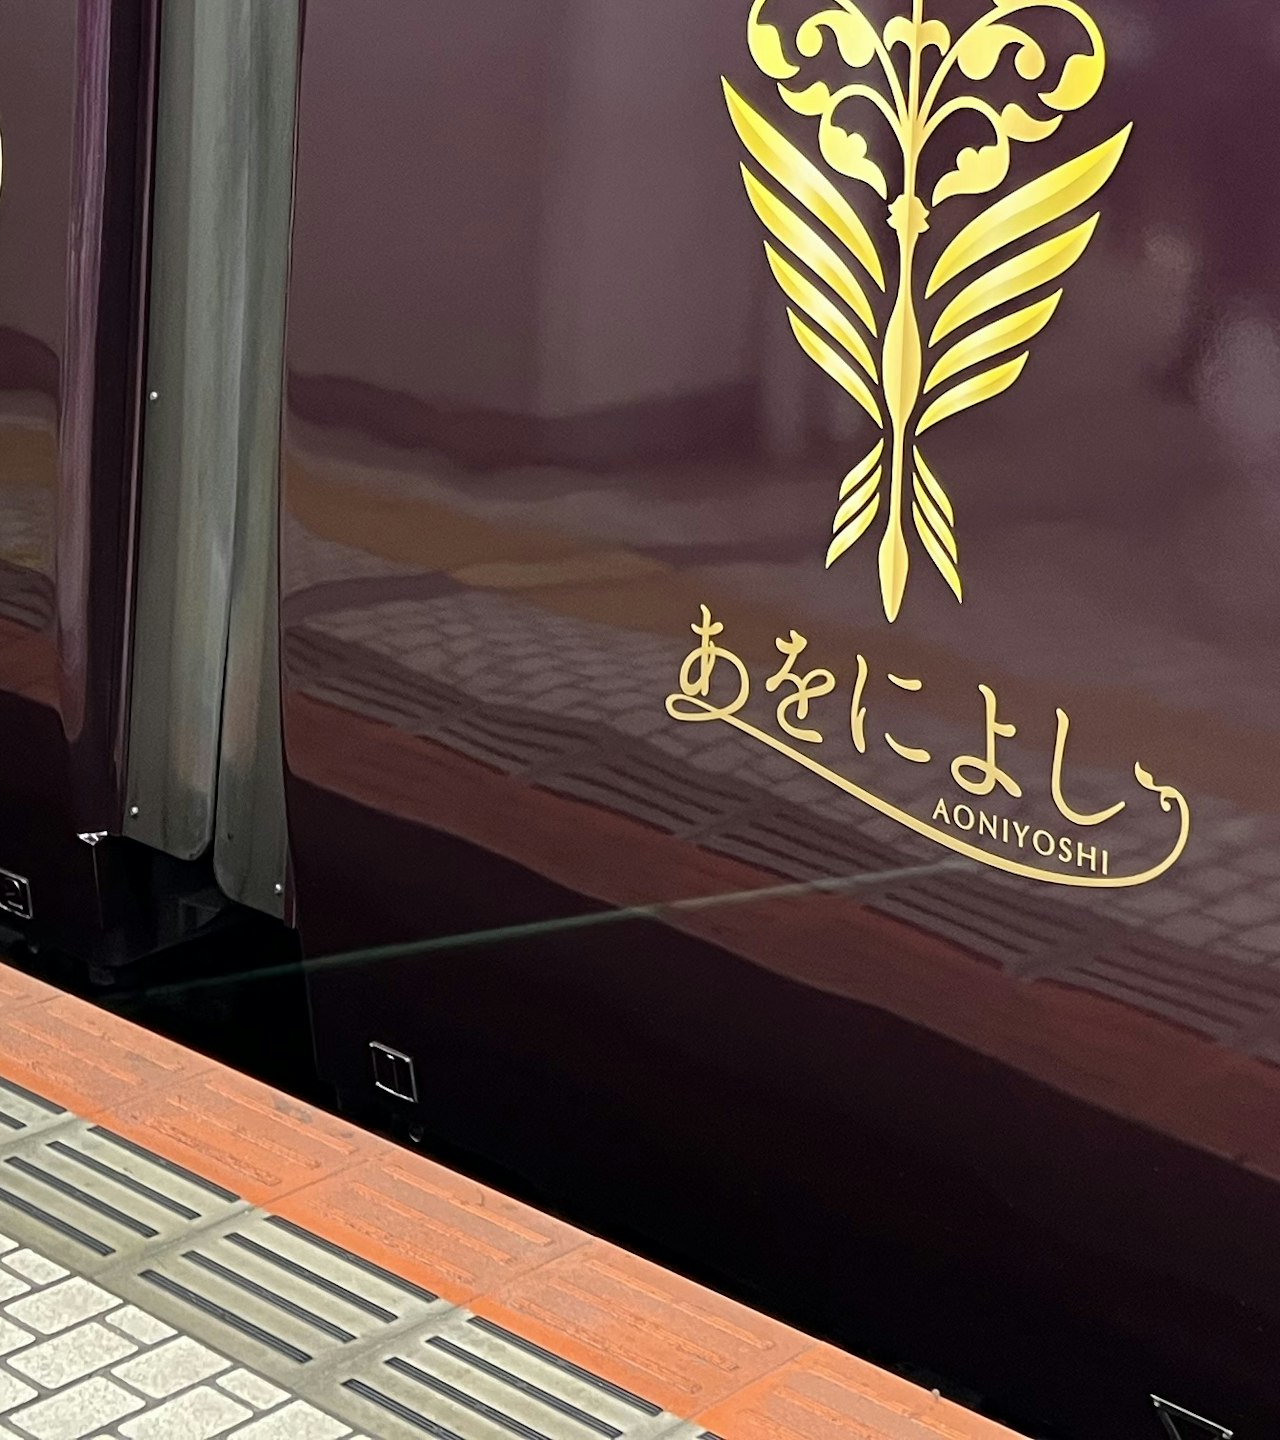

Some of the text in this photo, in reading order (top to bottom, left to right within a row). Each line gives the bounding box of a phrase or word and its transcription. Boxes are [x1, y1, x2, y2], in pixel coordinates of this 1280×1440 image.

[664, 603, 1127, 827] あをによし
[931, 796, 1111, 876] AONIYOSHI
